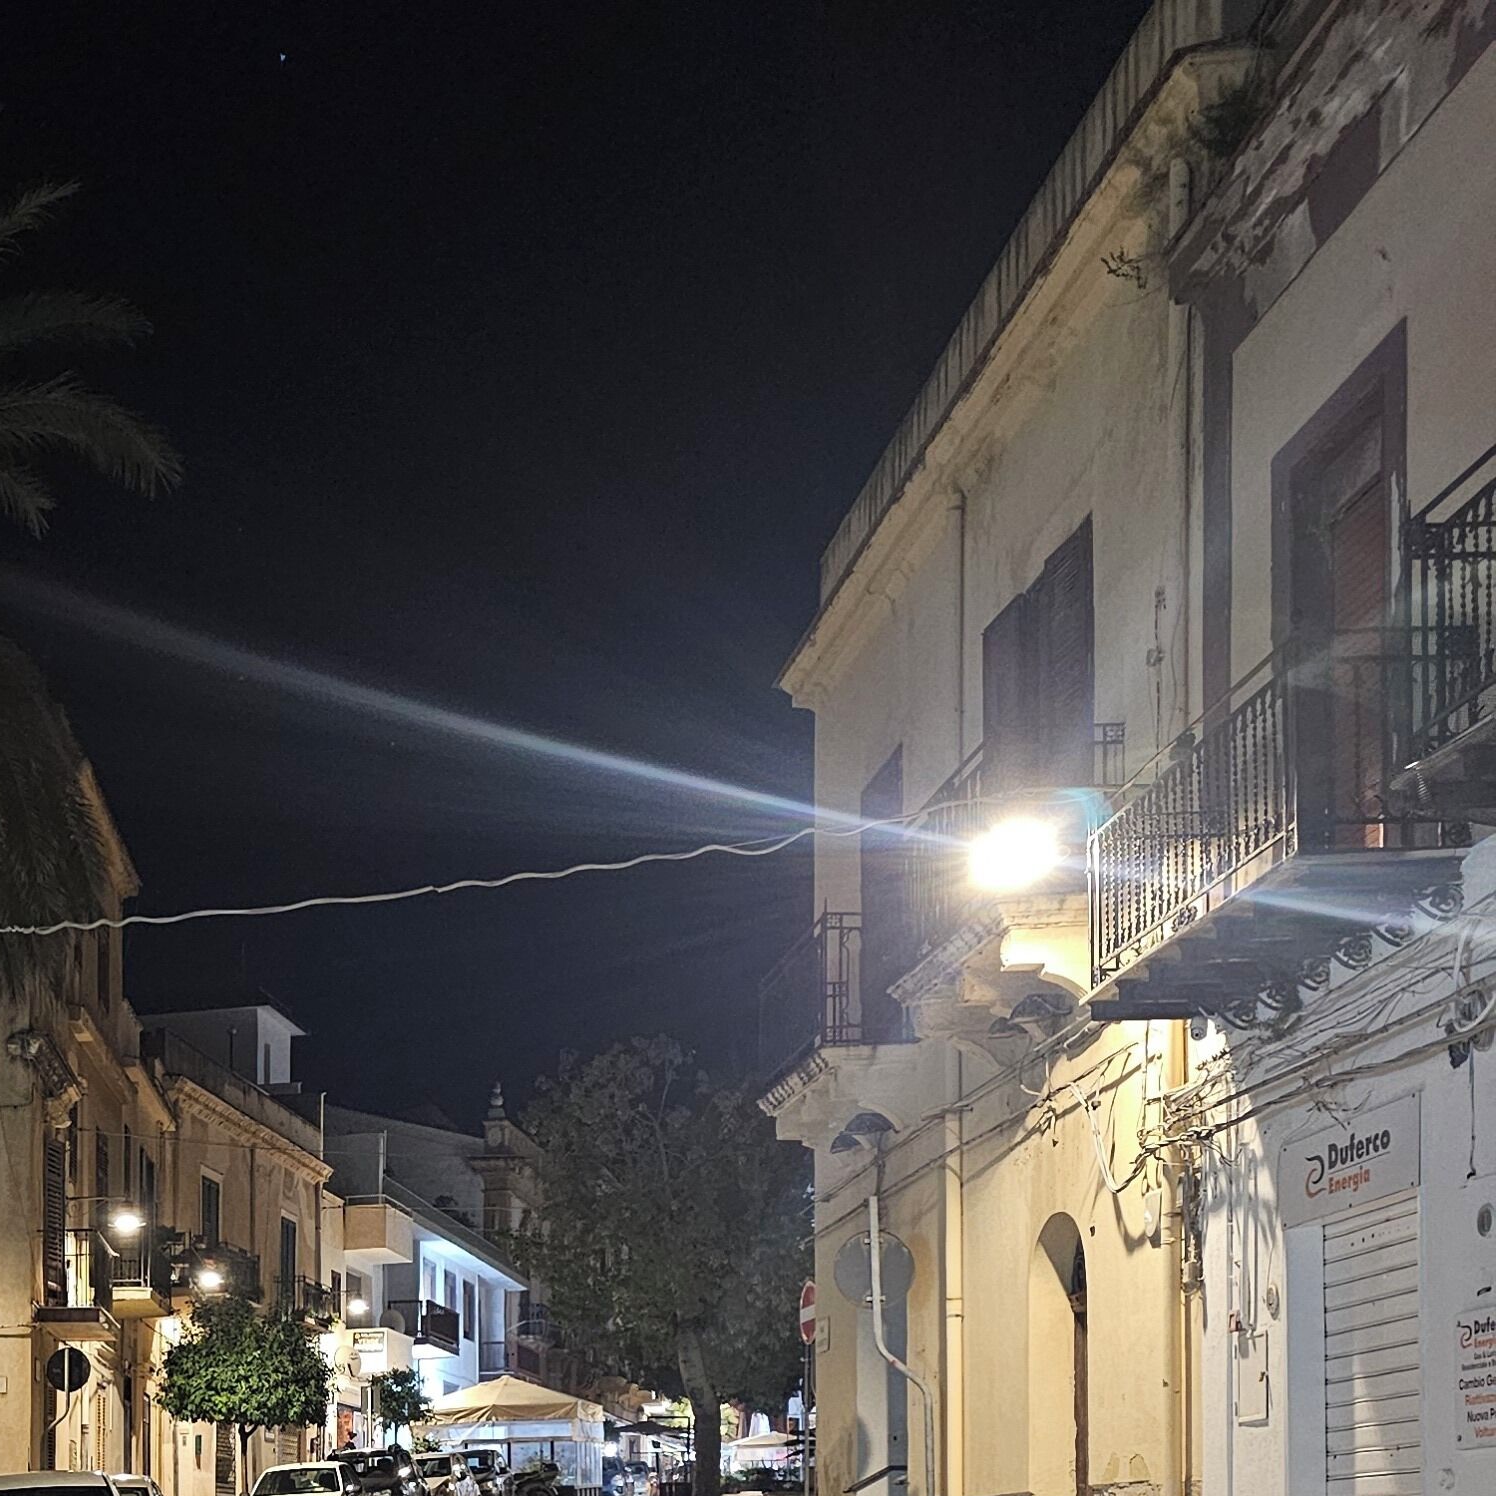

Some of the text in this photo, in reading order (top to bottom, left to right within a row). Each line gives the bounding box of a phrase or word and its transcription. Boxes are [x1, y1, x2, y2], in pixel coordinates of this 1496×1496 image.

[1328, 1129, 1390, 1170] Duferco
[1328, 1165, 1370, 1194] Energia
[1459, 1376, 1485, 1390] Cambio
[1467, 1410, 1489, 1423] Nuova
